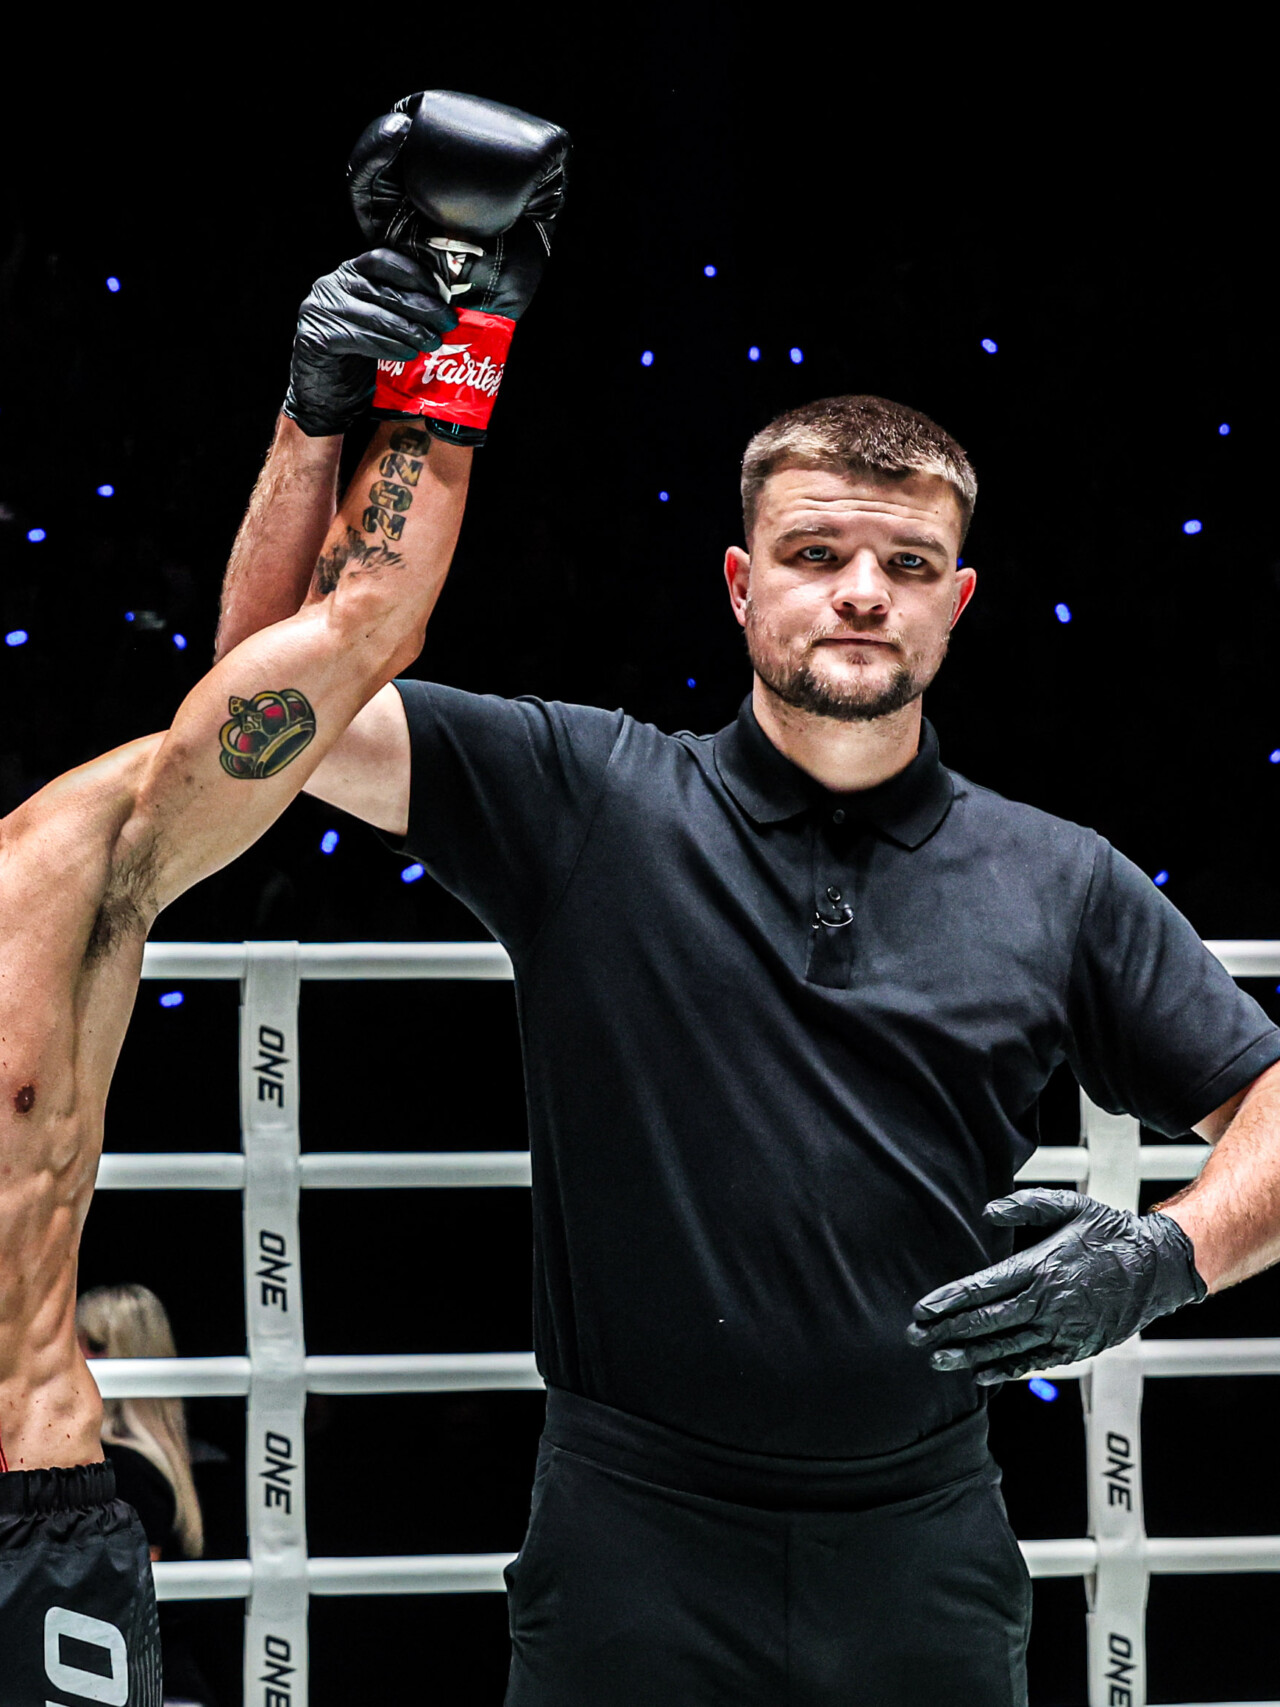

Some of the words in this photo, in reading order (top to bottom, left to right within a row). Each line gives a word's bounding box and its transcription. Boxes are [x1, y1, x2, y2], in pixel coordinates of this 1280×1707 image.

[254, 1024, 290, 1109] ONE
[256, 1229, 291, 1313] ONE
[260, 1431, 297, 1515] ONE
[1104, 1431, 1134, 1512] ONE
[45, 1606, 129, 1707] O
[1105, 1633, 1135, 1707] ONE
